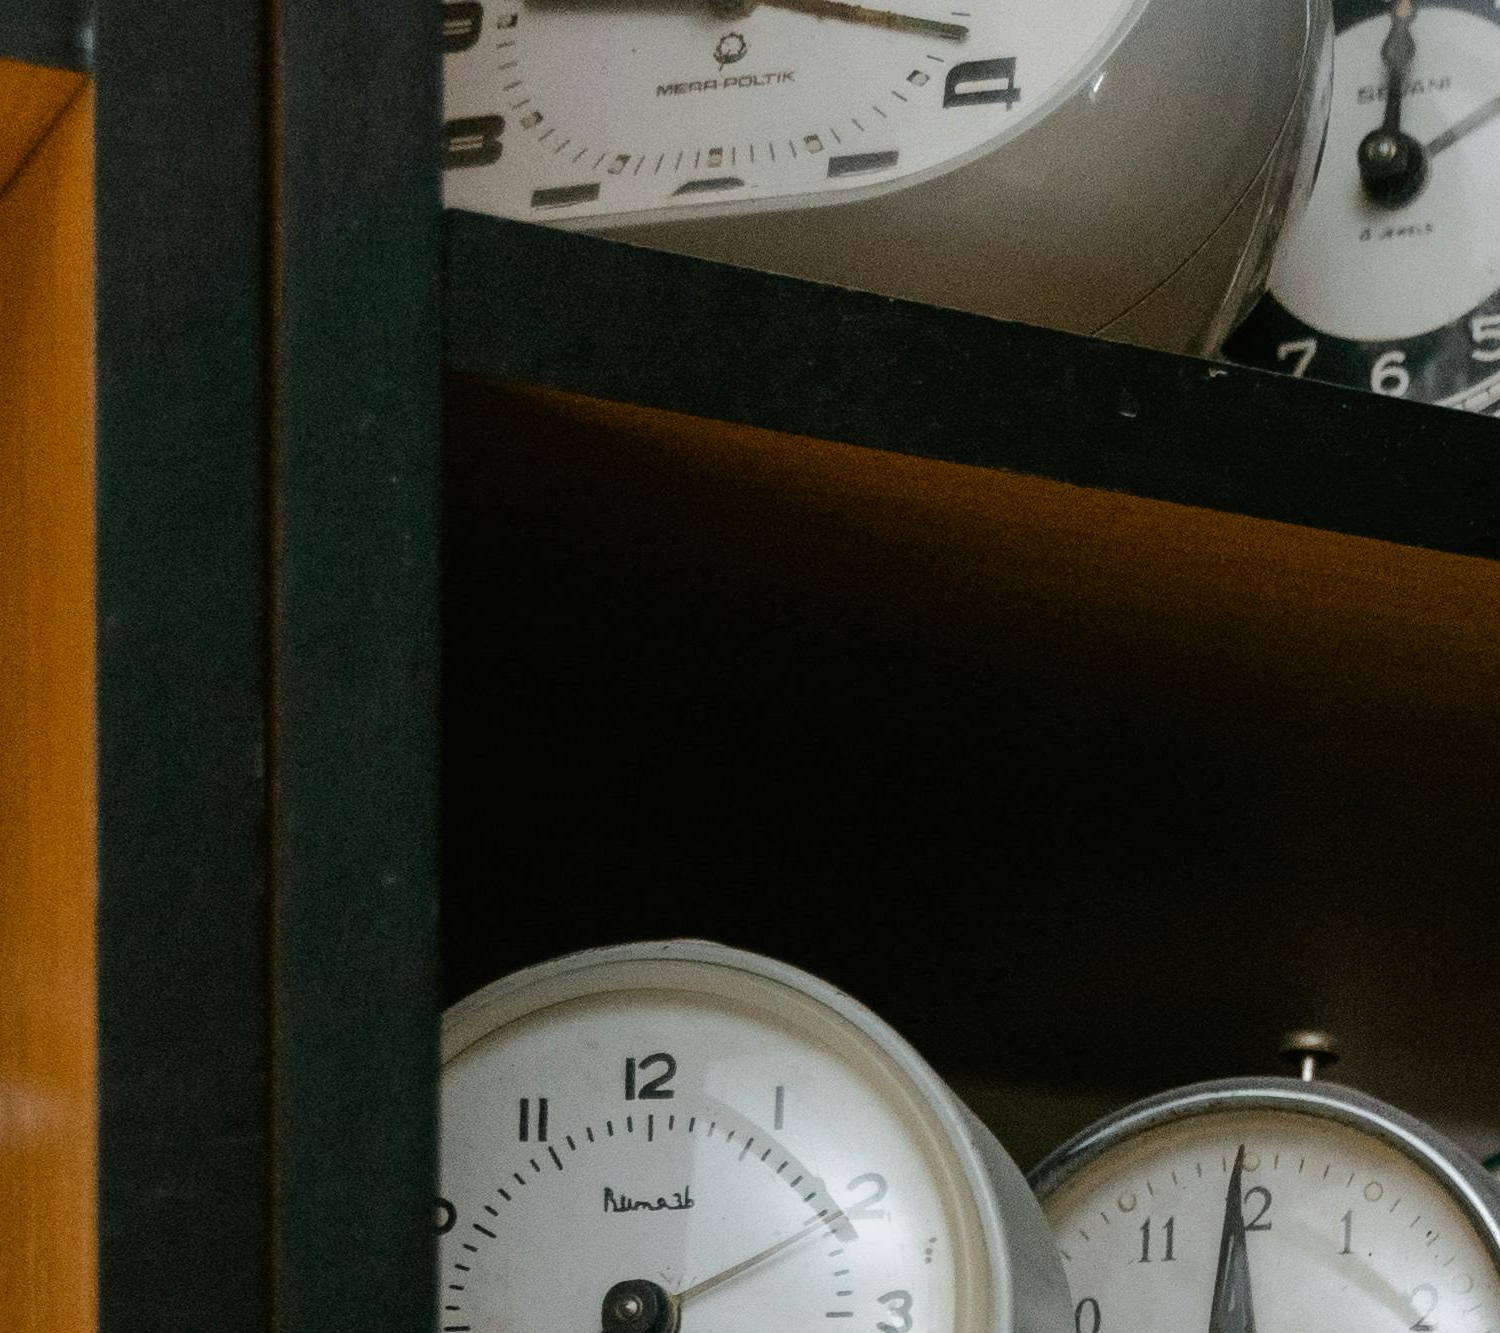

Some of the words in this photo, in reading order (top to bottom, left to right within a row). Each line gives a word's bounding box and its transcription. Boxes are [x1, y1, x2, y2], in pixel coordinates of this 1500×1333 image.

[1277, 339, 1318, 377] 7
[1370, 350, 1409, 399] 6
[625, 1053, 677, 1100] 12
[519, 1097, 549, 1142] 11
[774, 1086, 785, 1130] 1
[845, 1172, 889, 1220] 2
[1138, 1215, 1177, 1263] 11
[1339, 1210, 1355, 1255] 1
[1410, 1283, 1440, 1332] 2
